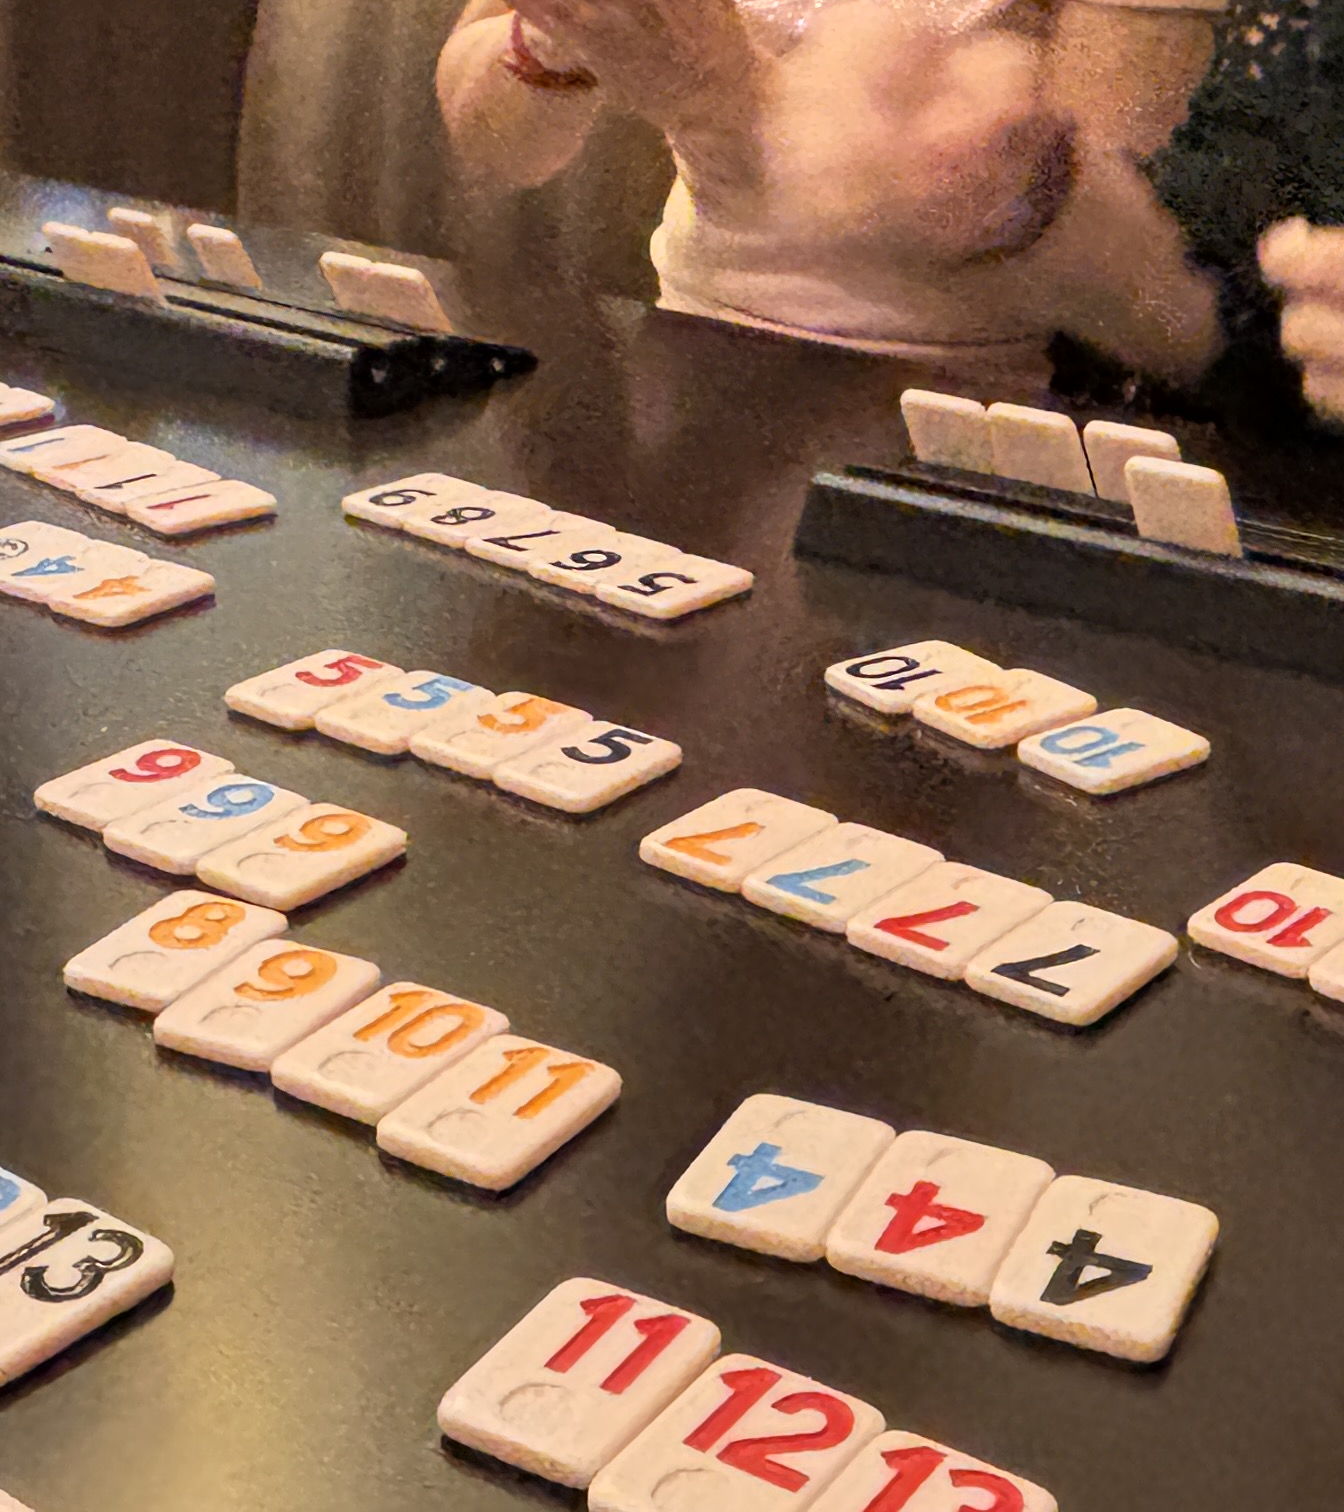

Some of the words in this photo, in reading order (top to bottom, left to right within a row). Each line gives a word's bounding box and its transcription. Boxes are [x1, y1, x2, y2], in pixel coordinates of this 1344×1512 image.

[430, 506, 496, 525] 8
[483, 529, 560, 552] 7
[11, 555, 85, 576] 4
[72, 575, 152, 599] 4
[617, 571, 698, 597] 5
[845, 655, 944, 690] 10
[294, 653, 386, 688] 5
[383, 675, 476, 710] 5
[476, 698, 570, 735] 5
[560, 727, 656, 766] 5
[934, 685, 1028, 724] 10
[1037, 725, 1147, 769] 10
[109, 747, 202, 783] 9
[179, 782, 275, 819] 9
[273, 813, 372, 853] 9
[659, 820, 765, 866] 7
[765, 858, 870, 905] 7
[873, 900, 980, 952] 7
[1213, 889, 1334, 950] 10
[992, 943, 1101, 998] 7
[148, 900, 247, 951] 8
[234, 950, 339, 1002] 9
[351, 990, 486, 1059] 10
[468, 1046, 597, 1120] 11
[712, 1142, 825, 1214] 4
[874, 1180, 986, 1255] 4
[1039, 1228, 1154, 1306] 4
[543, 1293, 692, 1396] 11
[682, 1365, 857, 1494] 12
